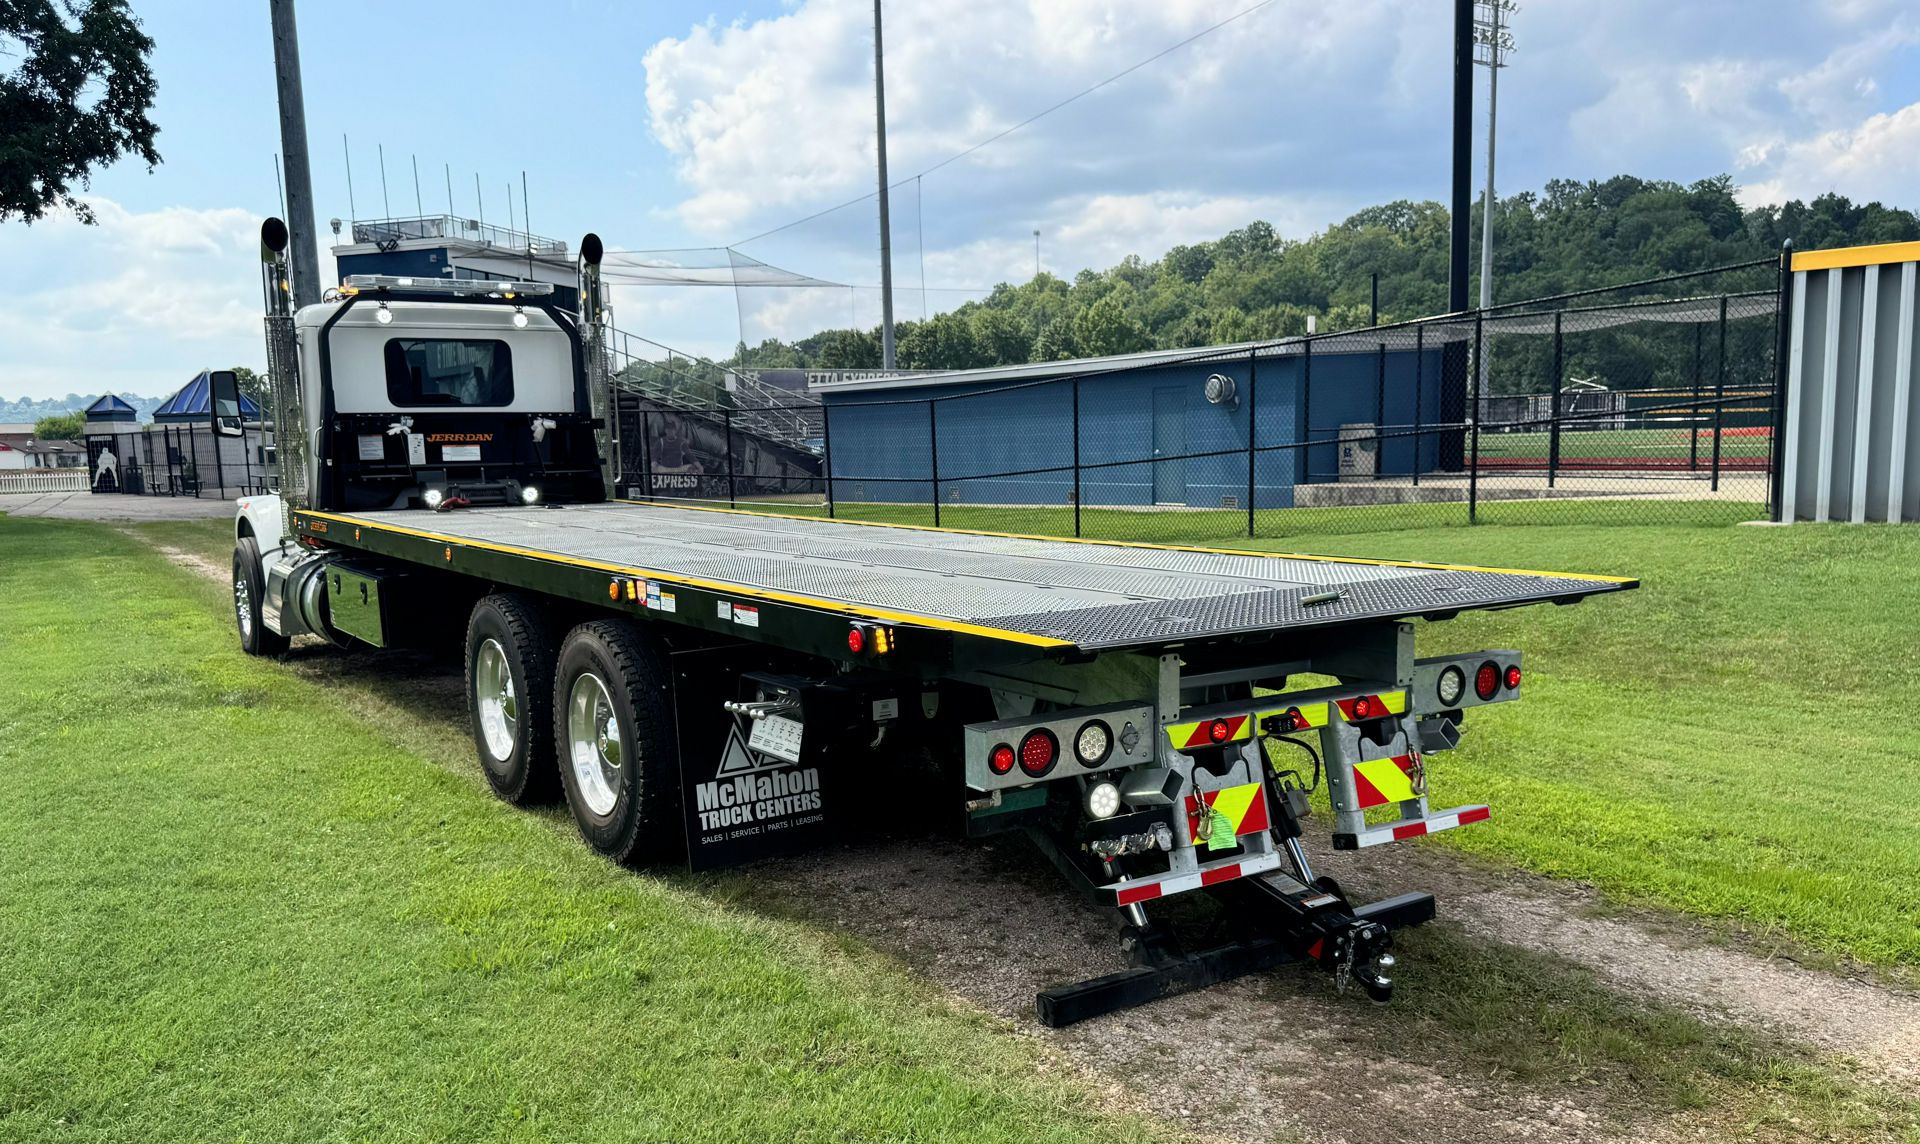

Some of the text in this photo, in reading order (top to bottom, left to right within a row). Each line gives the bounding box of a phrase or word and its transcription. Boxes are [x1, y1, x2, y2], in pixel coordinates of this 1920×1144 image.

[651, 474, 698, 488] EXPRESS
[696, 767, 820, 812] McMahon
[699, 791, 822, 831] TRUCK CENTERS
[701, 814, 824, 845] SALES SERVICE PARTS LEASING
